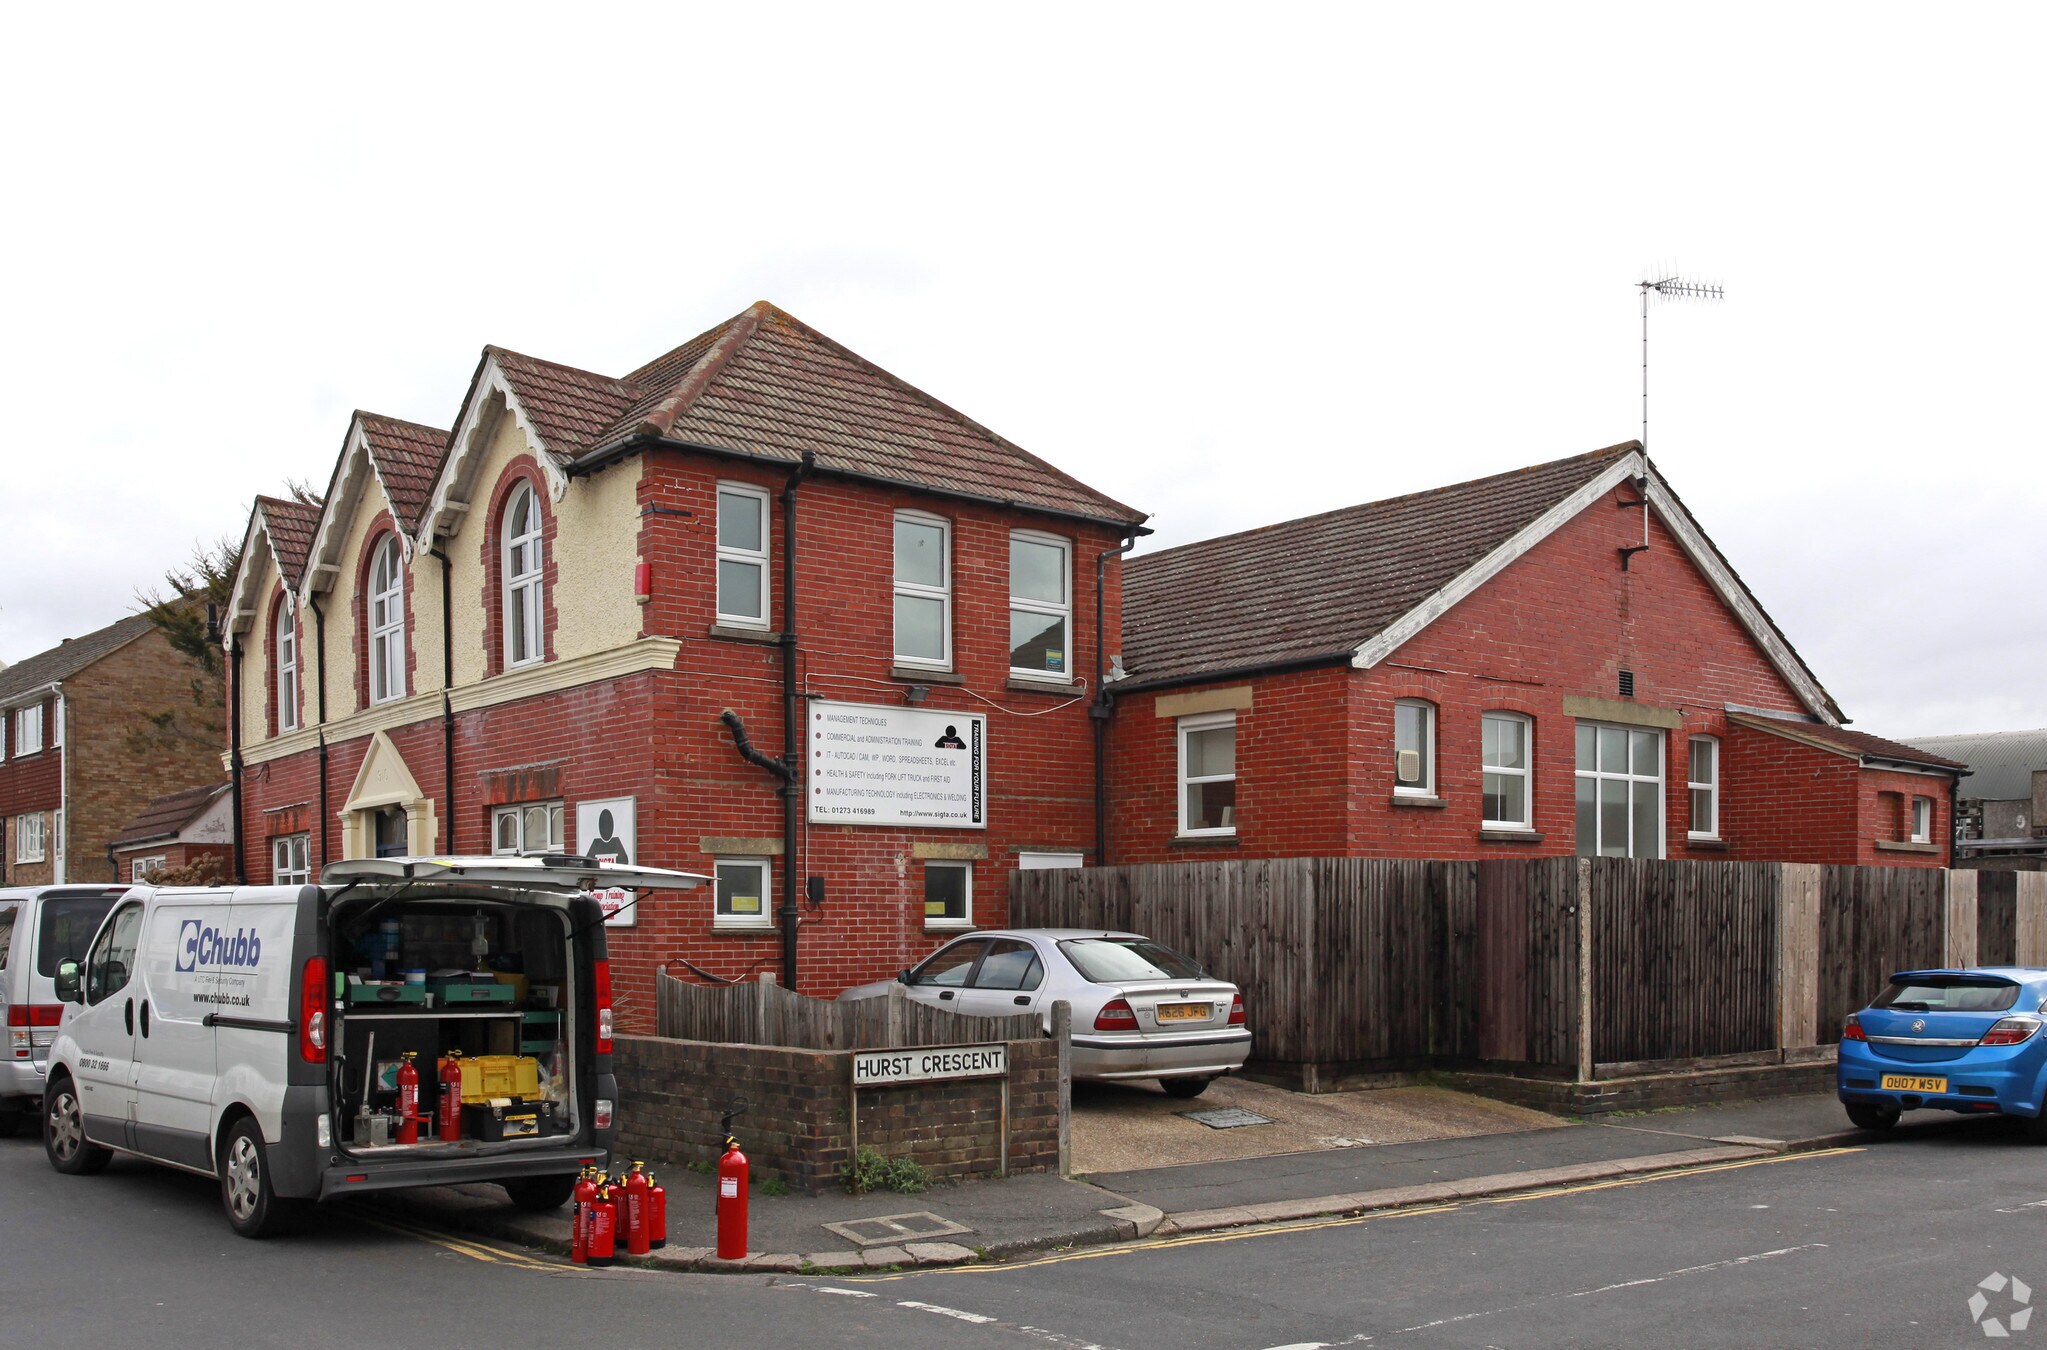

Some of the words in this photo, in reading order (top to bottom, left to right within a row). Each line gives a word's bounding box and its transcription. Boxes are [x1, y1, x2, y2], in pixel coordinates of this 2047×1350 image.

[827, 714, 858, 724] MANAGEMENT
[860, 716, 888, 726] TECHNIQUES
[827, 732, 856, 743] COMMERCIAL
[866, 735, 902, 745] ADMINISTRATION
[902, 737, 923, 747] TRAINING
[826, 769, 844, 778] HEALTH
[848, 770, 866, 779] SAFETY
[885, 772, 897, 781] FORK
[897, 773, 907, 781] LIFT
[907, 774, 921, 782] TRUCK
[930, 775, 943, 783] FIRST
[943, 775, 951, 784] AID
[826, 787, 864, 797] MANUFACTURING
[865, 789, 895, 798] TECHNOLOGY
[896, 791, 914, 801] including
[914, 791, 943, 801] ELECTRONICS
[947, 793, 967, 802] WELDING
[831, 806, 851, 814] 01273
[852, 807, 875, 815] 416989
[900, 809, 967, 819] http://www.sigta.co.uk
[605, 889, 625, 903] Training
[198, 927, 261, 967] Chubb
[193, 992, 250, 1007] www.chubb.co.uk
[1158, 1007, 1185, 1018] R626
[857, 1057, 912, 1077] HURST
[922, 1051, 1001, 1073] CRESCENT
[1919, 1078, 1942, 1090] WSV
